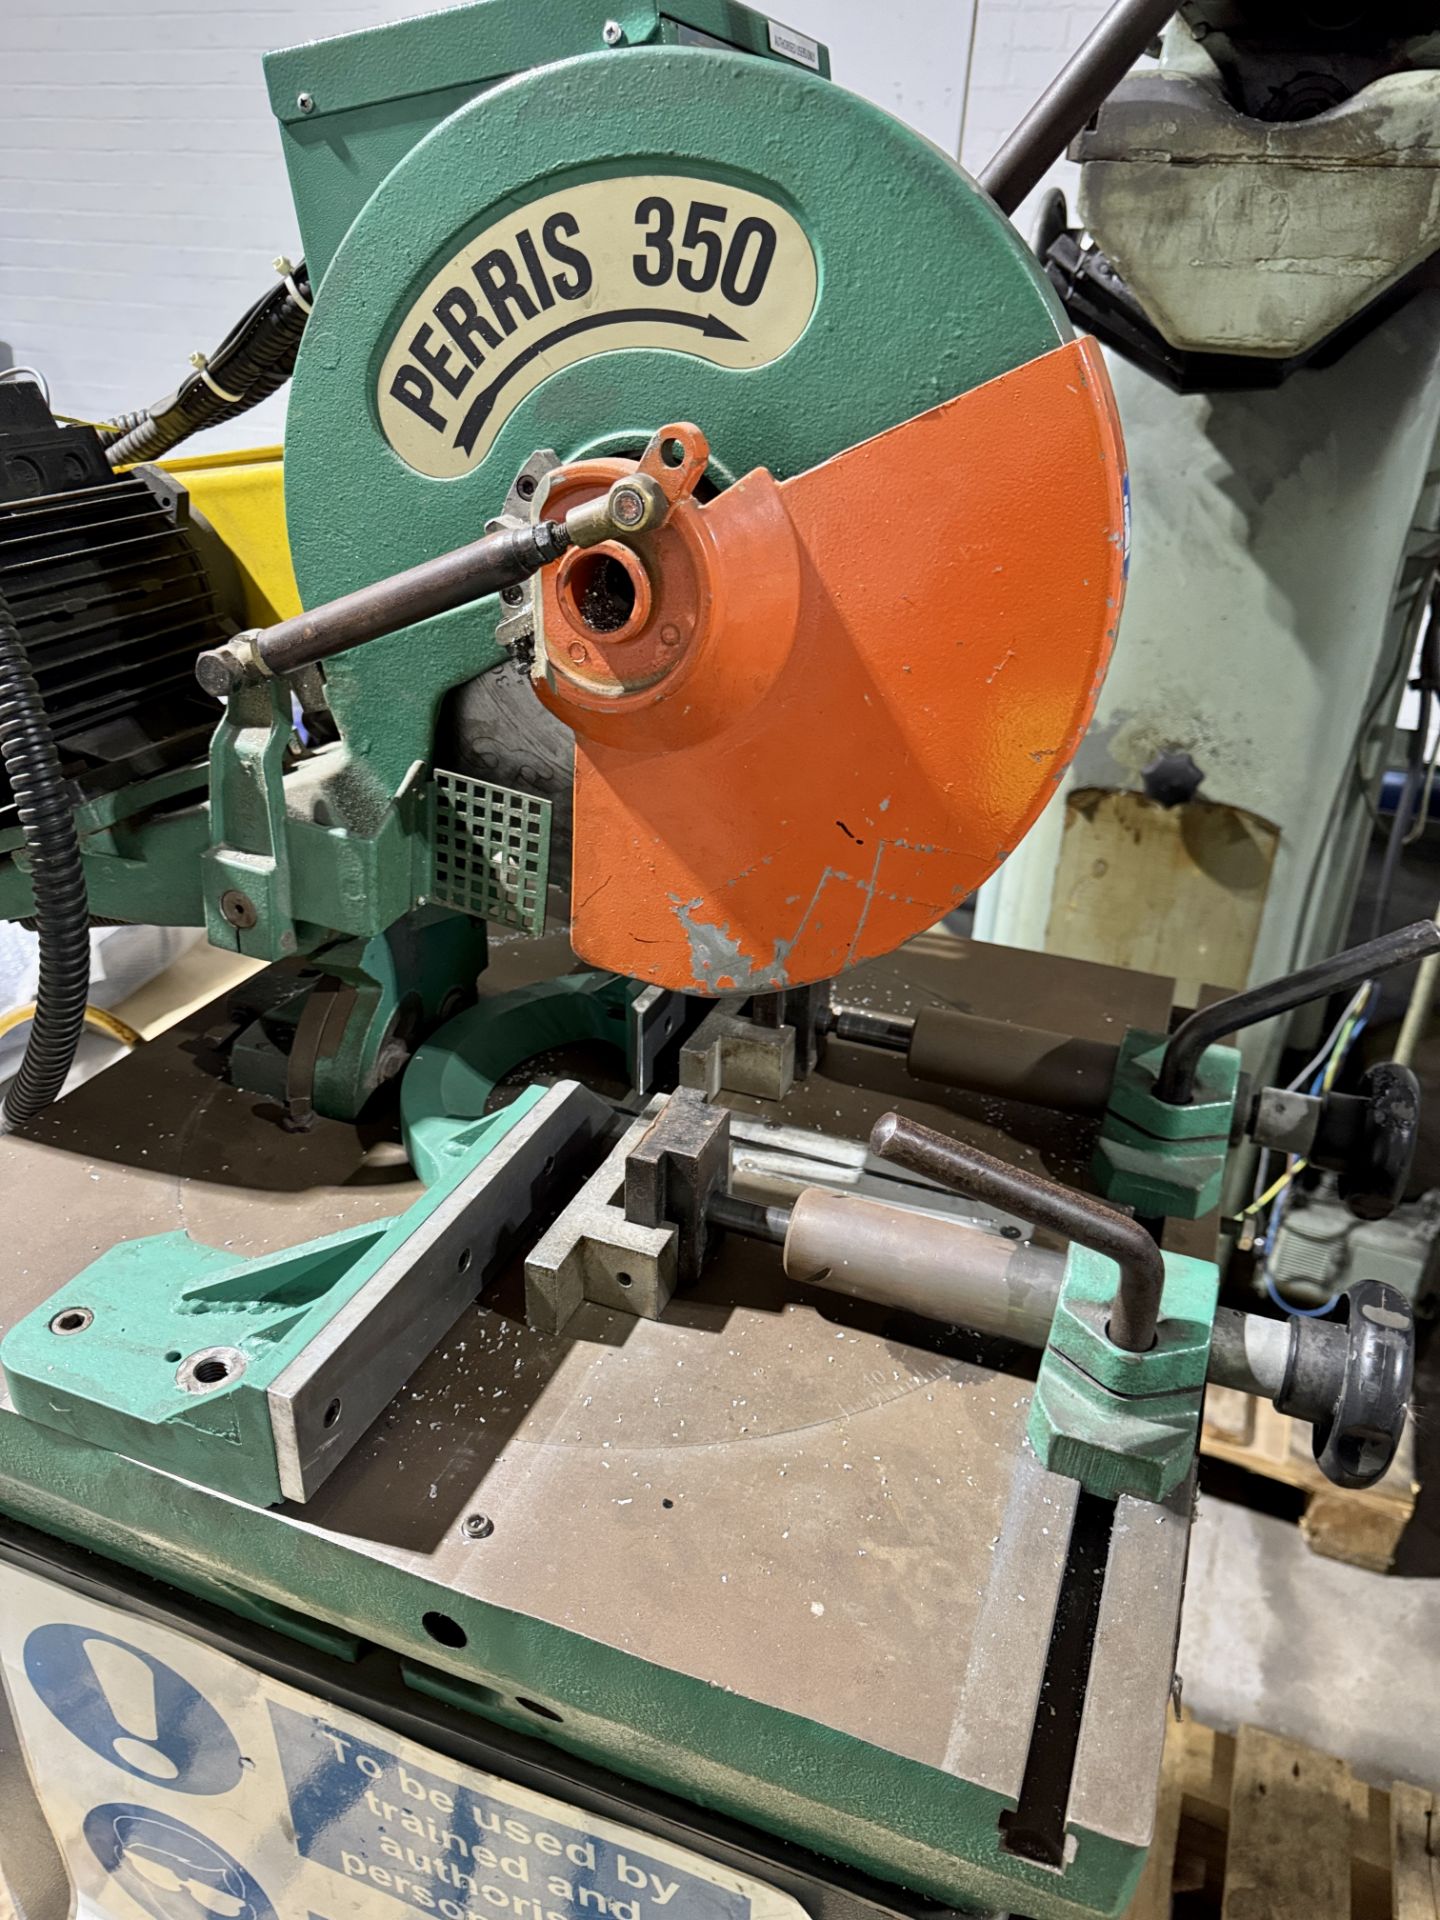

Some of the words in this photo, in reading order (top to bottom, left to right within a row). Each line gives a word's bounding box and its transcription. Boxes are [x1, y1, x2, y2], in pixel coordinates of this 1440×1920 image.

[390, 212, 593, 433] PERRIS
[633, 196, 777, 306] 350
[321, 1730, 383, 1779] To
[398, 1767, 455, 1813] be
[473, 1807, 596, 1870] used
[617, 1855, 680, 1905] by
[364, 1790, 529, 1883] trained
[548, 1875, 641, 1920] and
